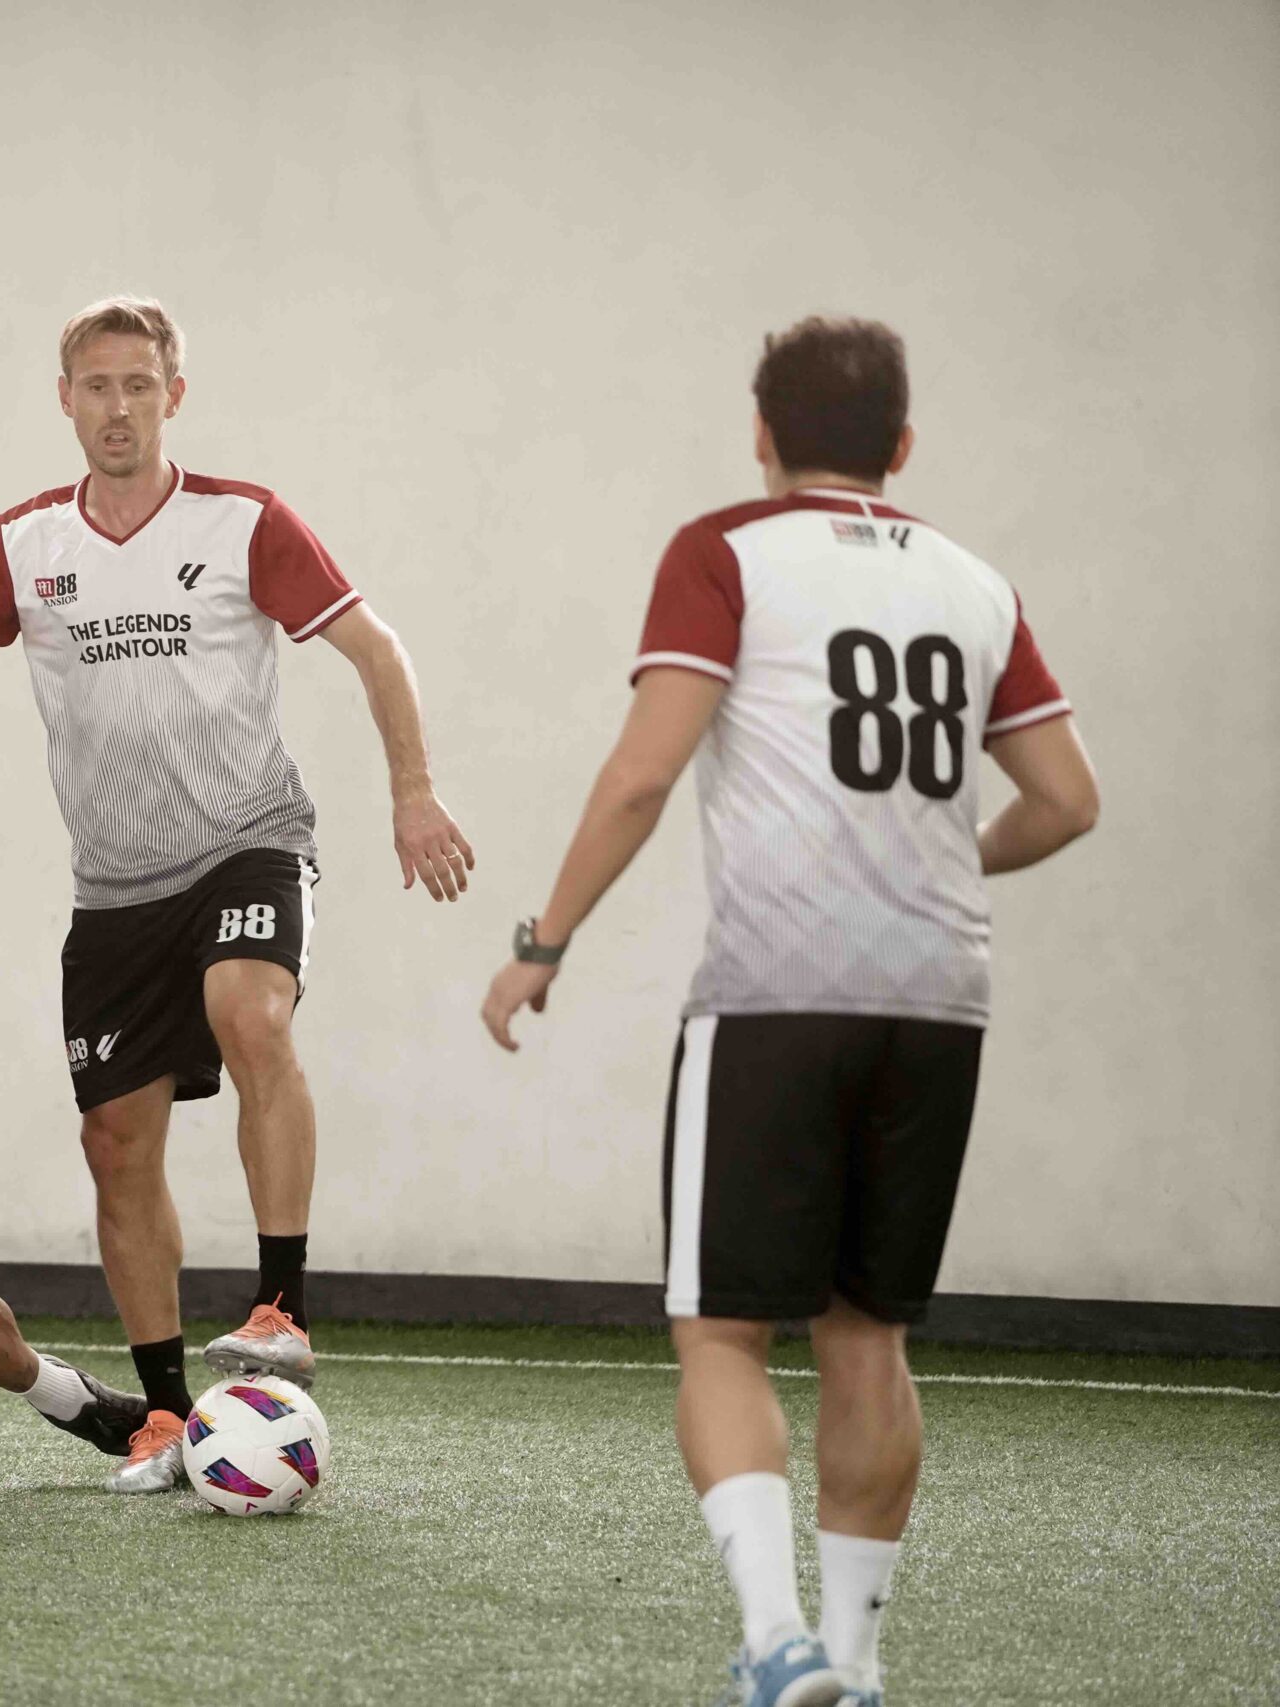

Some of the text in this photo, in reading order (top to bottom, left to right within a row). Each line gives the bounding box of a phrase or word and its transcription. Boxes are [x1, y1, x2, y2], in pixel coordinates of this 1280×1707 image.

[44, 594, 78, 607] ANSION
[67, 613, 192, 642] THE LEGENDS
[827, 628, 968, 800] 88
